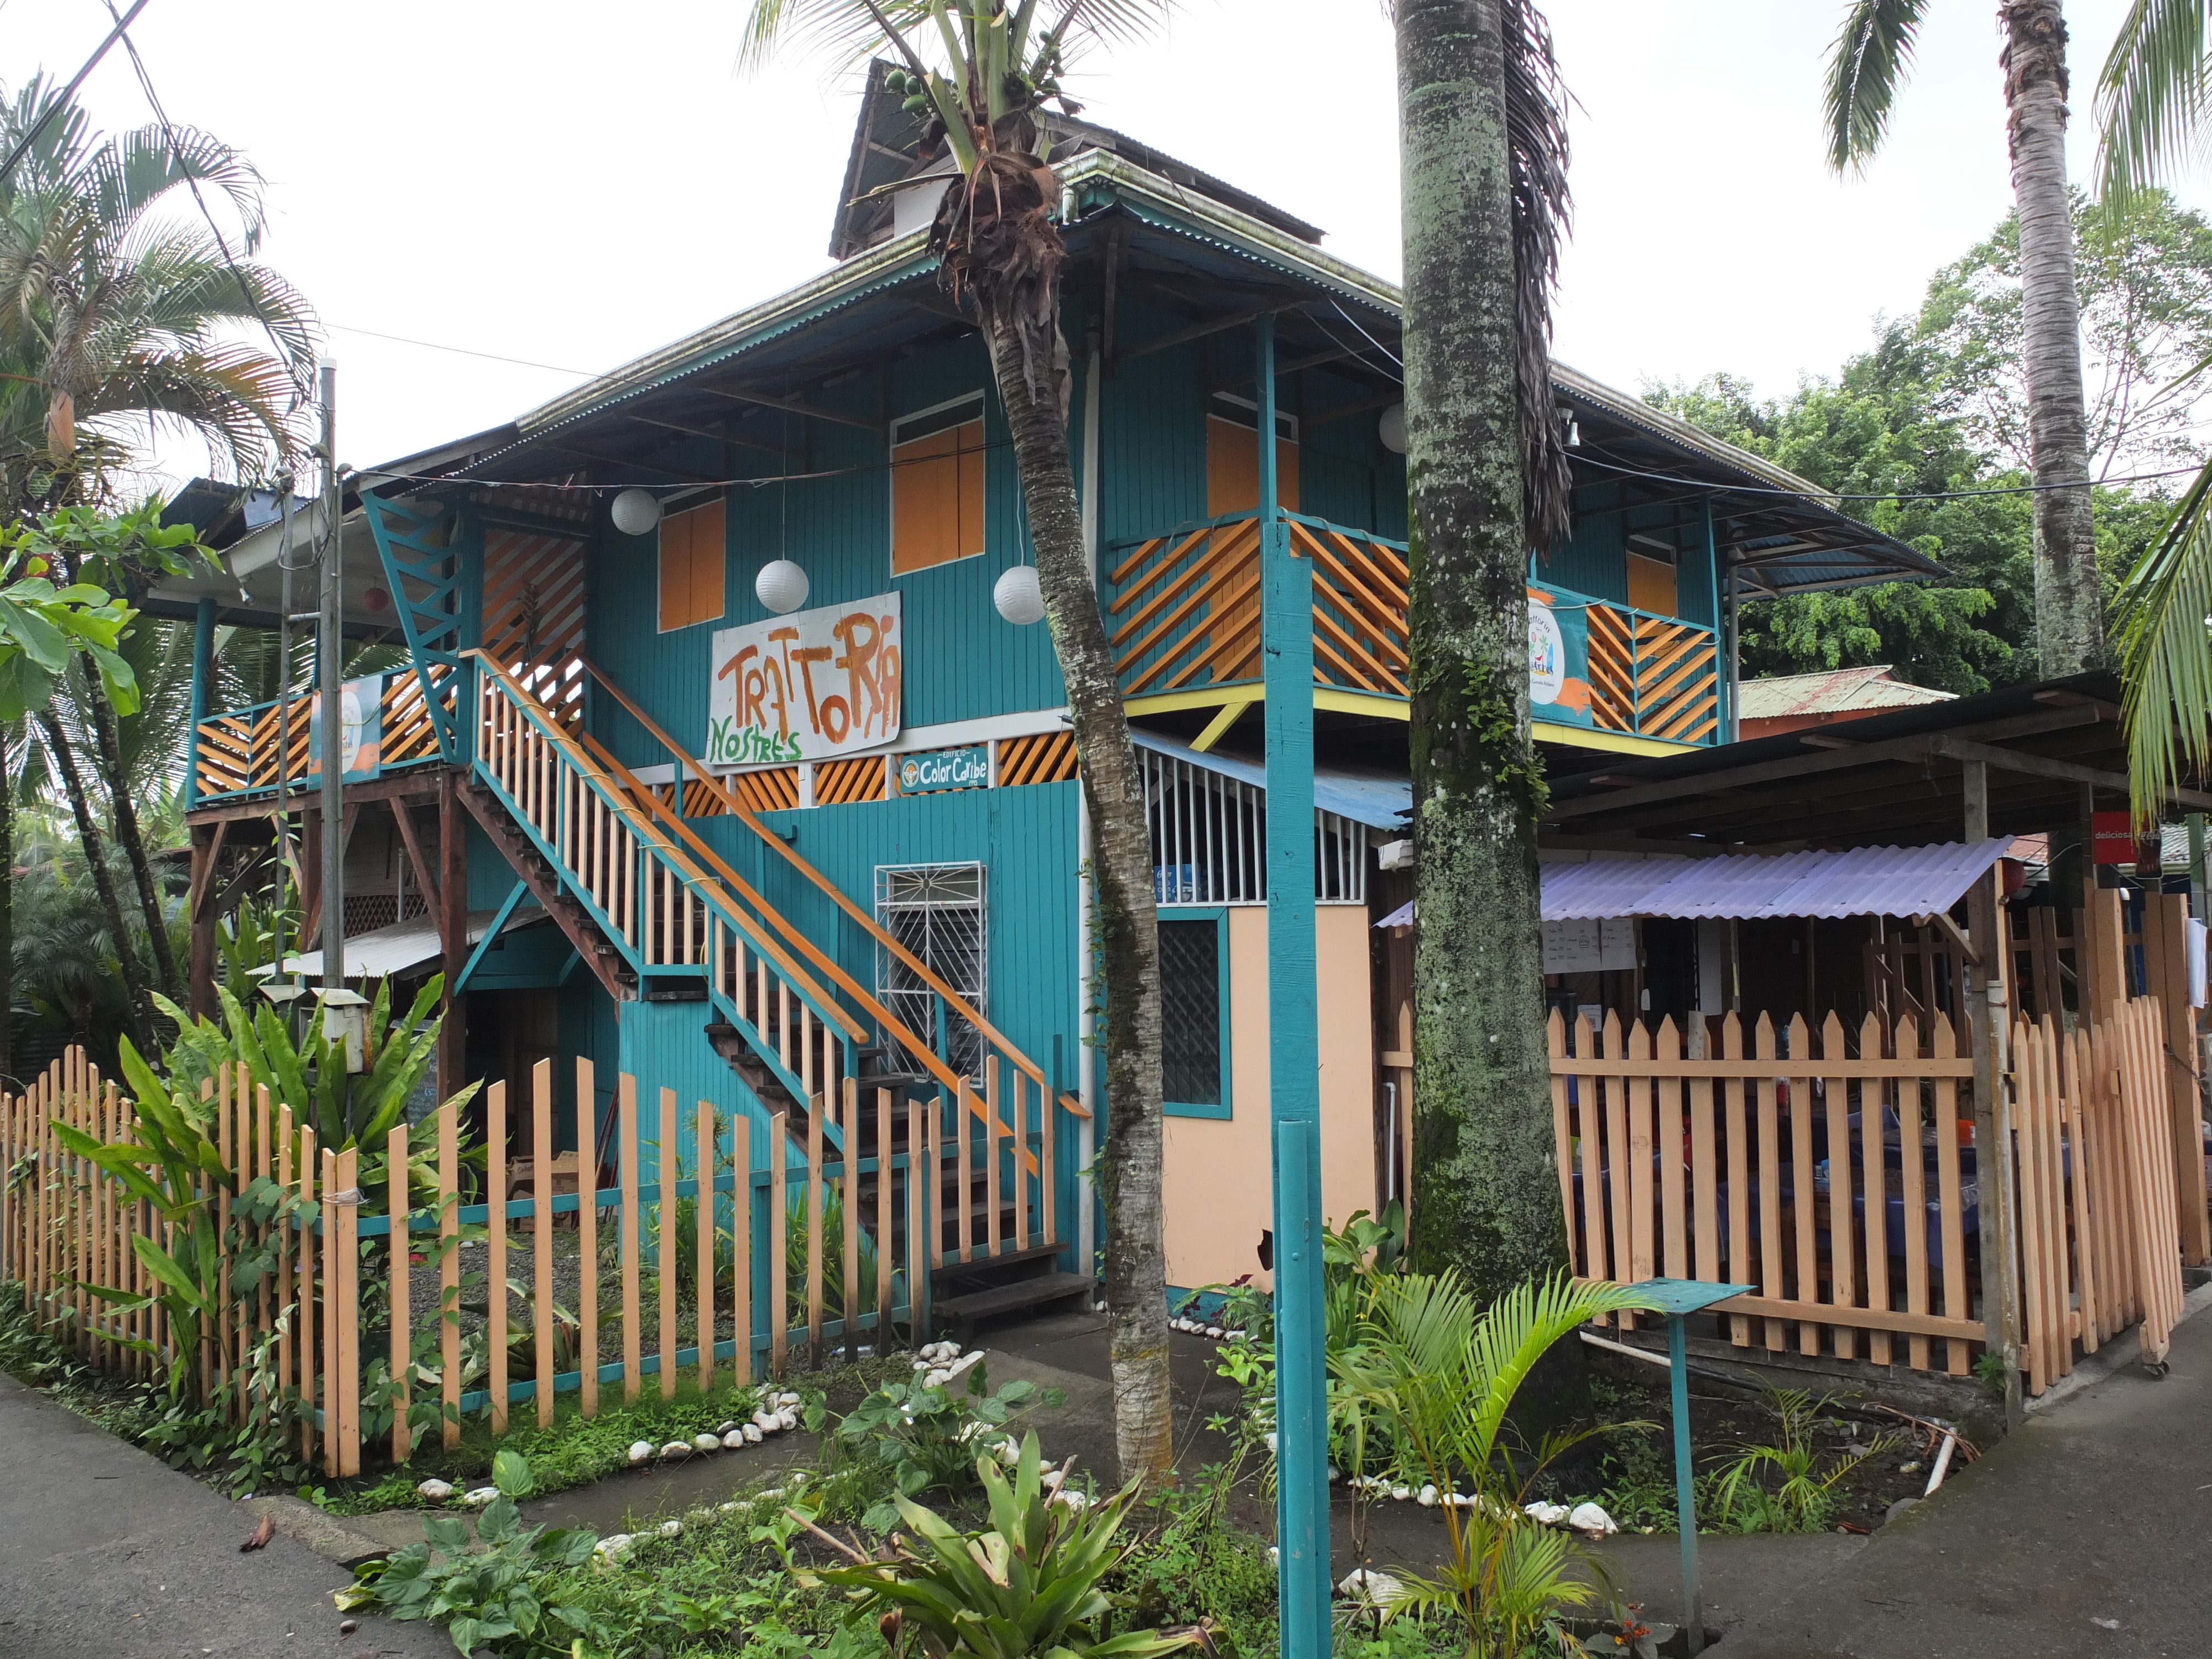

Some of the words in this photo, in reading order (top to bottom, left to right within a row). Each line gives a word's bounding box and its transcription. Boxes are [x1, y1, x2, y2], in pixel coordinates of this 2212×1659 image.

[1528, 615, 1550, 633] attoria
[942, 749, 966, 759] EDIFICIO
[920, 758, 951, 784] Color
[952, 754, 987, 782] Caribe
